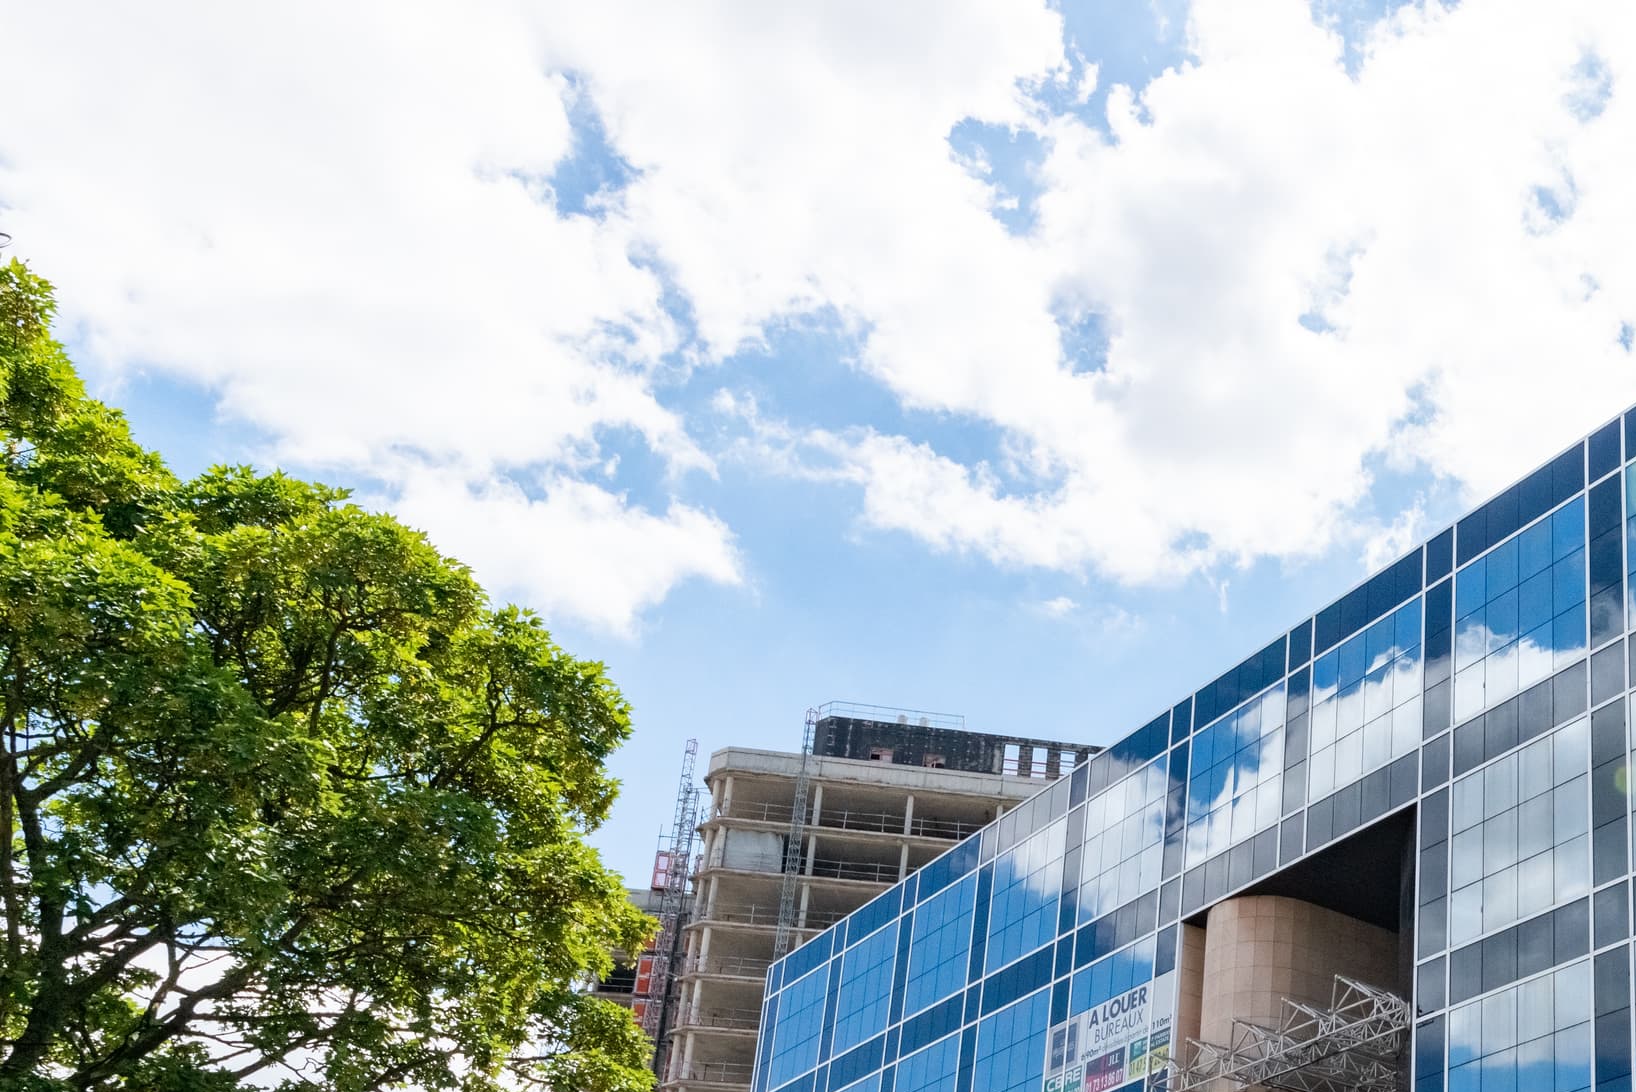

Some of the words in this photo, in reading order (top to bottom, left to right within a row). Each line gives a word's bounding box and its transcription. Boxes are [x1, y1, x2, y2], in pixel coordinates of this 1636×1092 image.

[1089, 1010, 1098, 1029] A
[1102, 986, 1147, 1021] LOUER
[1095, 1008, 1144, 1044] BUREAUX
[1047, 1067, 1081, 1092] CBRE
